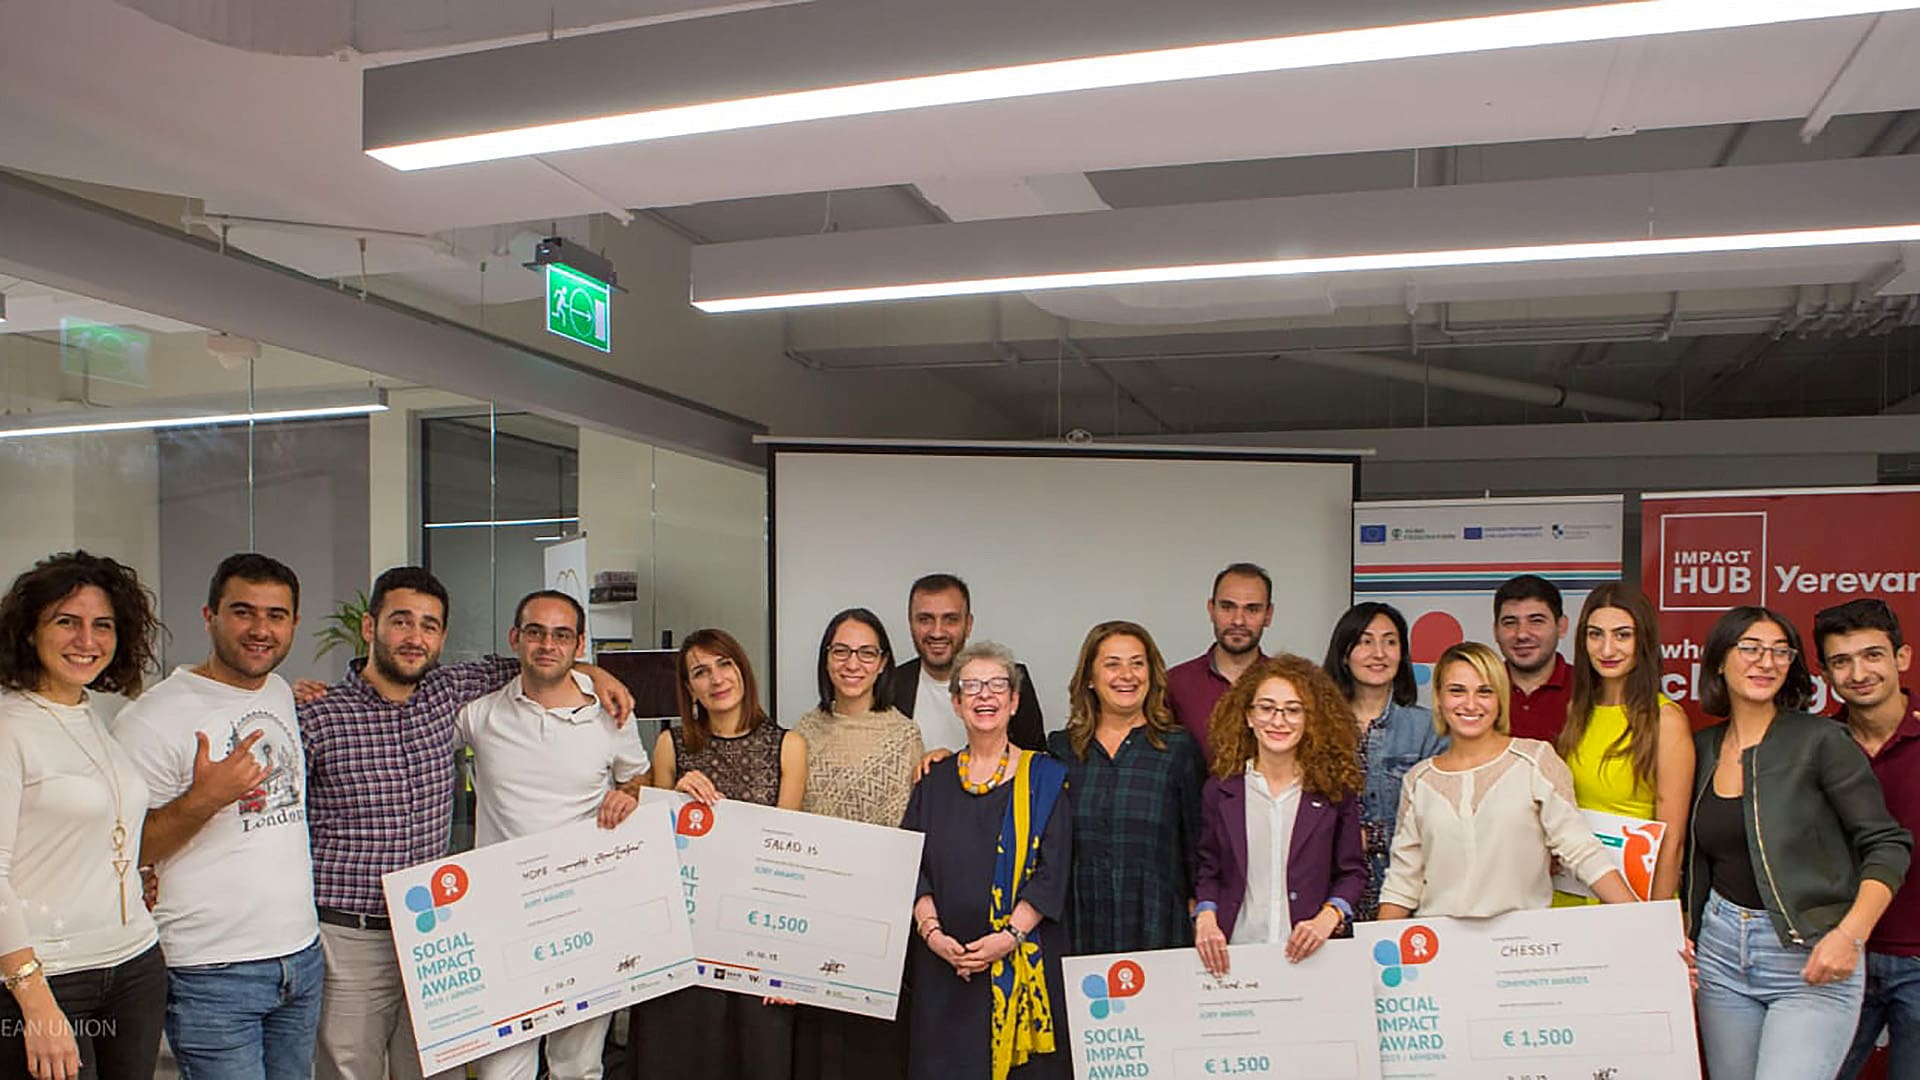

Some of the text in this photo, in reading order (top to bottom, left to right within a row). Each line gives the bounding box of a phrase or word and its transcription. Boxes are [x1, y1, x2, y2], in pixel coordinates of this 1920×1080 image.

[1674, 550, 1751, 564] IMPACT
[1674, 566, 1751, 594] HUB
[764, 838, 802, 852] SALAD
[748, 911, 760, 926] €
[413, 931, 475, 963] SOCIAL
[534, 945, 545, 961] €
[416, 948, 475, 982] IMPACT
[421, 966, 482, 1000] AWARD
[1376, 996, 1440, 1014] SOCIAL
[1377, 1015, 1440, 1032] IMPACT
[1084, 1027, 1145, 1044] SOCIAL
[1379, 1033, 1444, 1051] AWARD
[1503, 1029, 1515, 1046] €
[1086, 1045, 1145, 1062] IMPACT
[1088, 1063, 1149, 1080] AWARD
[1205, 1058, 1216, 1073] €
